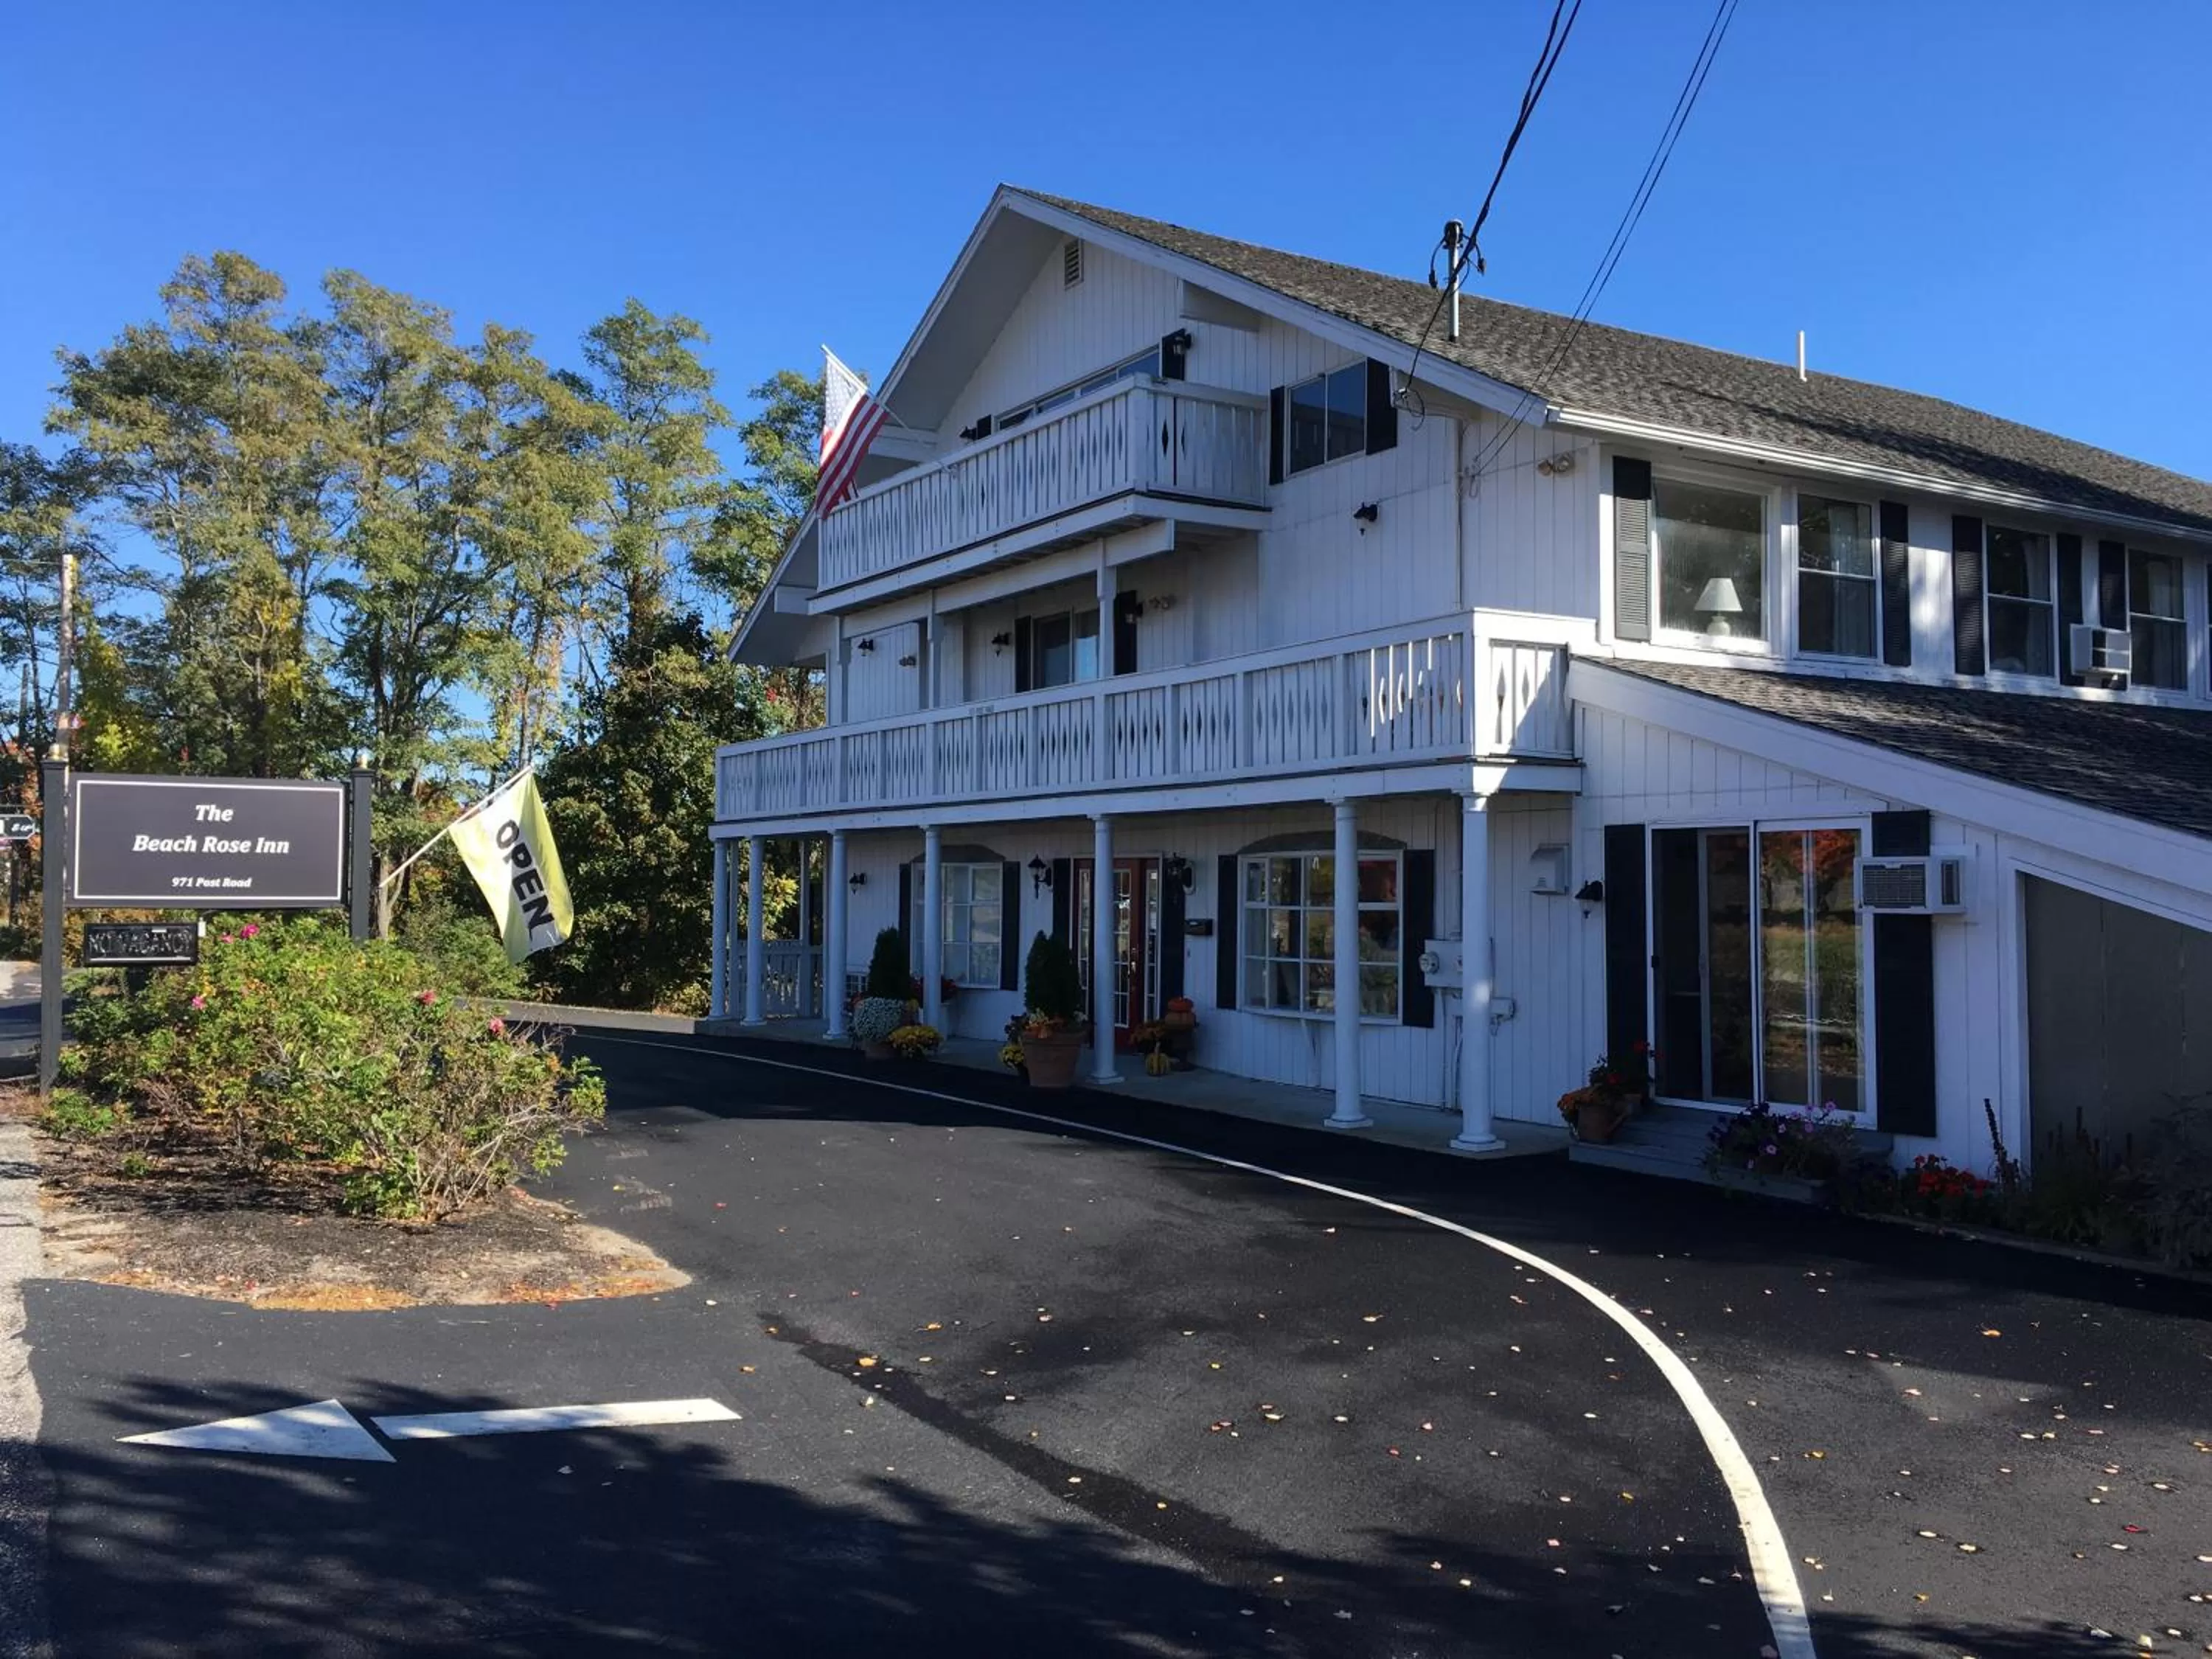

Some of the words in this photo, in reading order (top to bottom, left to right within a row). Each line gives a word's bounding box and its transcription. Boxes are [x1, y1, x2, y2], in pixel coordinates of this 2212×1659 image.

[195, 804, 234, 822] The
[133, 835, 197, 853] Beach
[202, 836, 251, 854] Rose
[255, 837, 290, 854] Inn
[172, 877, 193, 888] 971
[195, 877, 220, 888] Post
[222, 877, 252, 888] Road
[496, 820, 554, 937] OPEN
